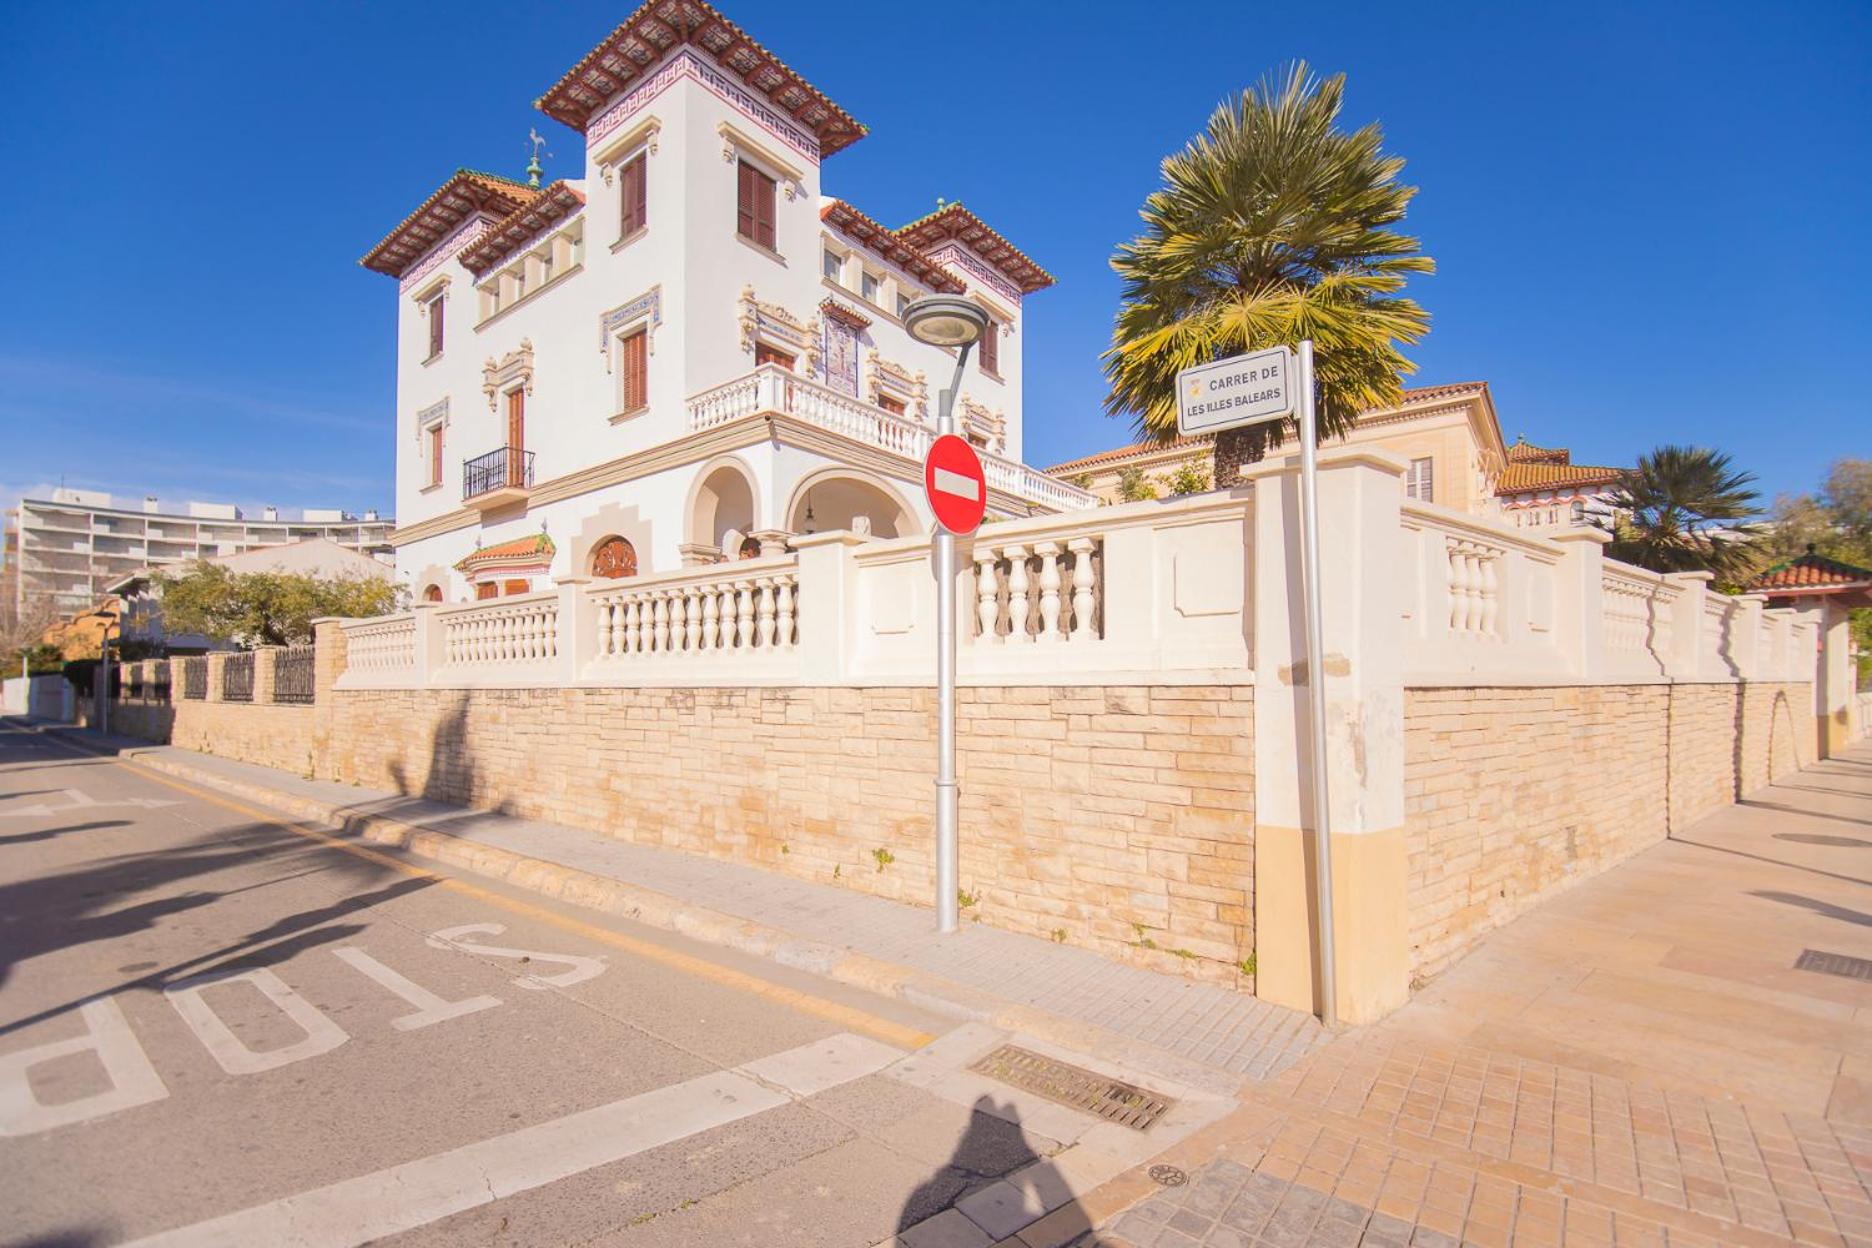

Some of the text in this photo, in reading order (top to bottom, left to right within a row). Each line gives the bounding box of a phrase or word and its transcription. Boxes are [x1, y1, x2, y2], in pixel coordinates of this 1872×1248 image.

[1209, 366, 1278, 391] CARRER DE
[1187, 388, 1281, 417] LES ILLES BALEARS
[0, 922, 608, 1137] STOP
